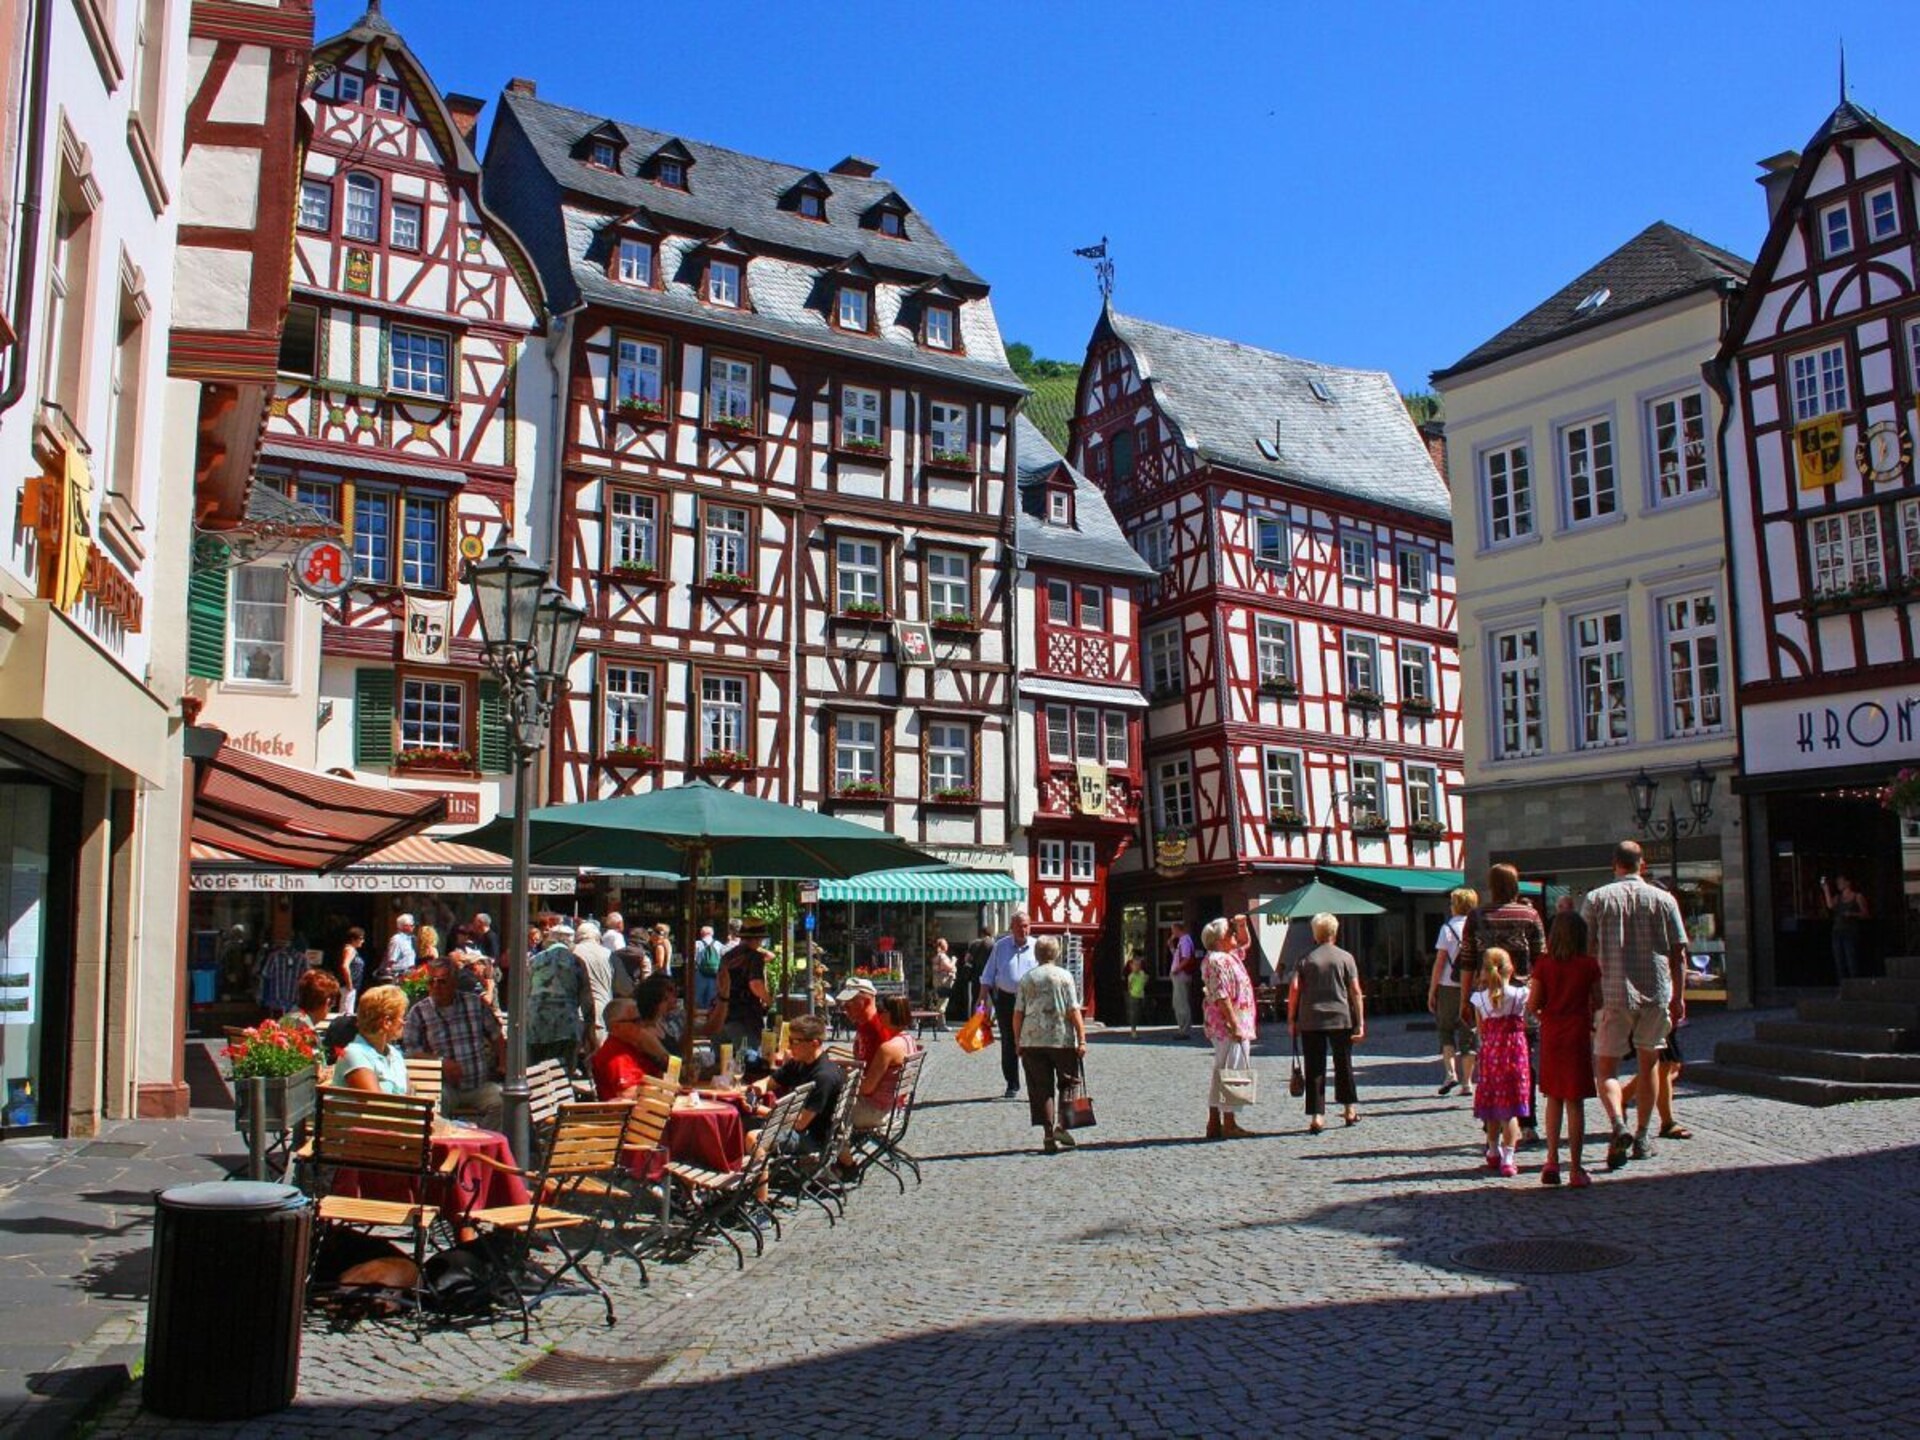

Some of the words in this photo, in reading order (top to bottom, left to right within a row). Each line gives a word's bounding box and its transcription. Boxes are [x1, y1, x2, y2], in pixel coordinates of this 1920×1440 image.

[226, 730, 294, 757] otheke
[444, 793, 477, 814] ius
[252, 874, 275, 889] für
[280, 874, 304, 889] Ihn
[331, 876, 378, 889] TOTO
[391, 876, 446, 890] LOTTO
[470, 878, 512, 890] Mode
